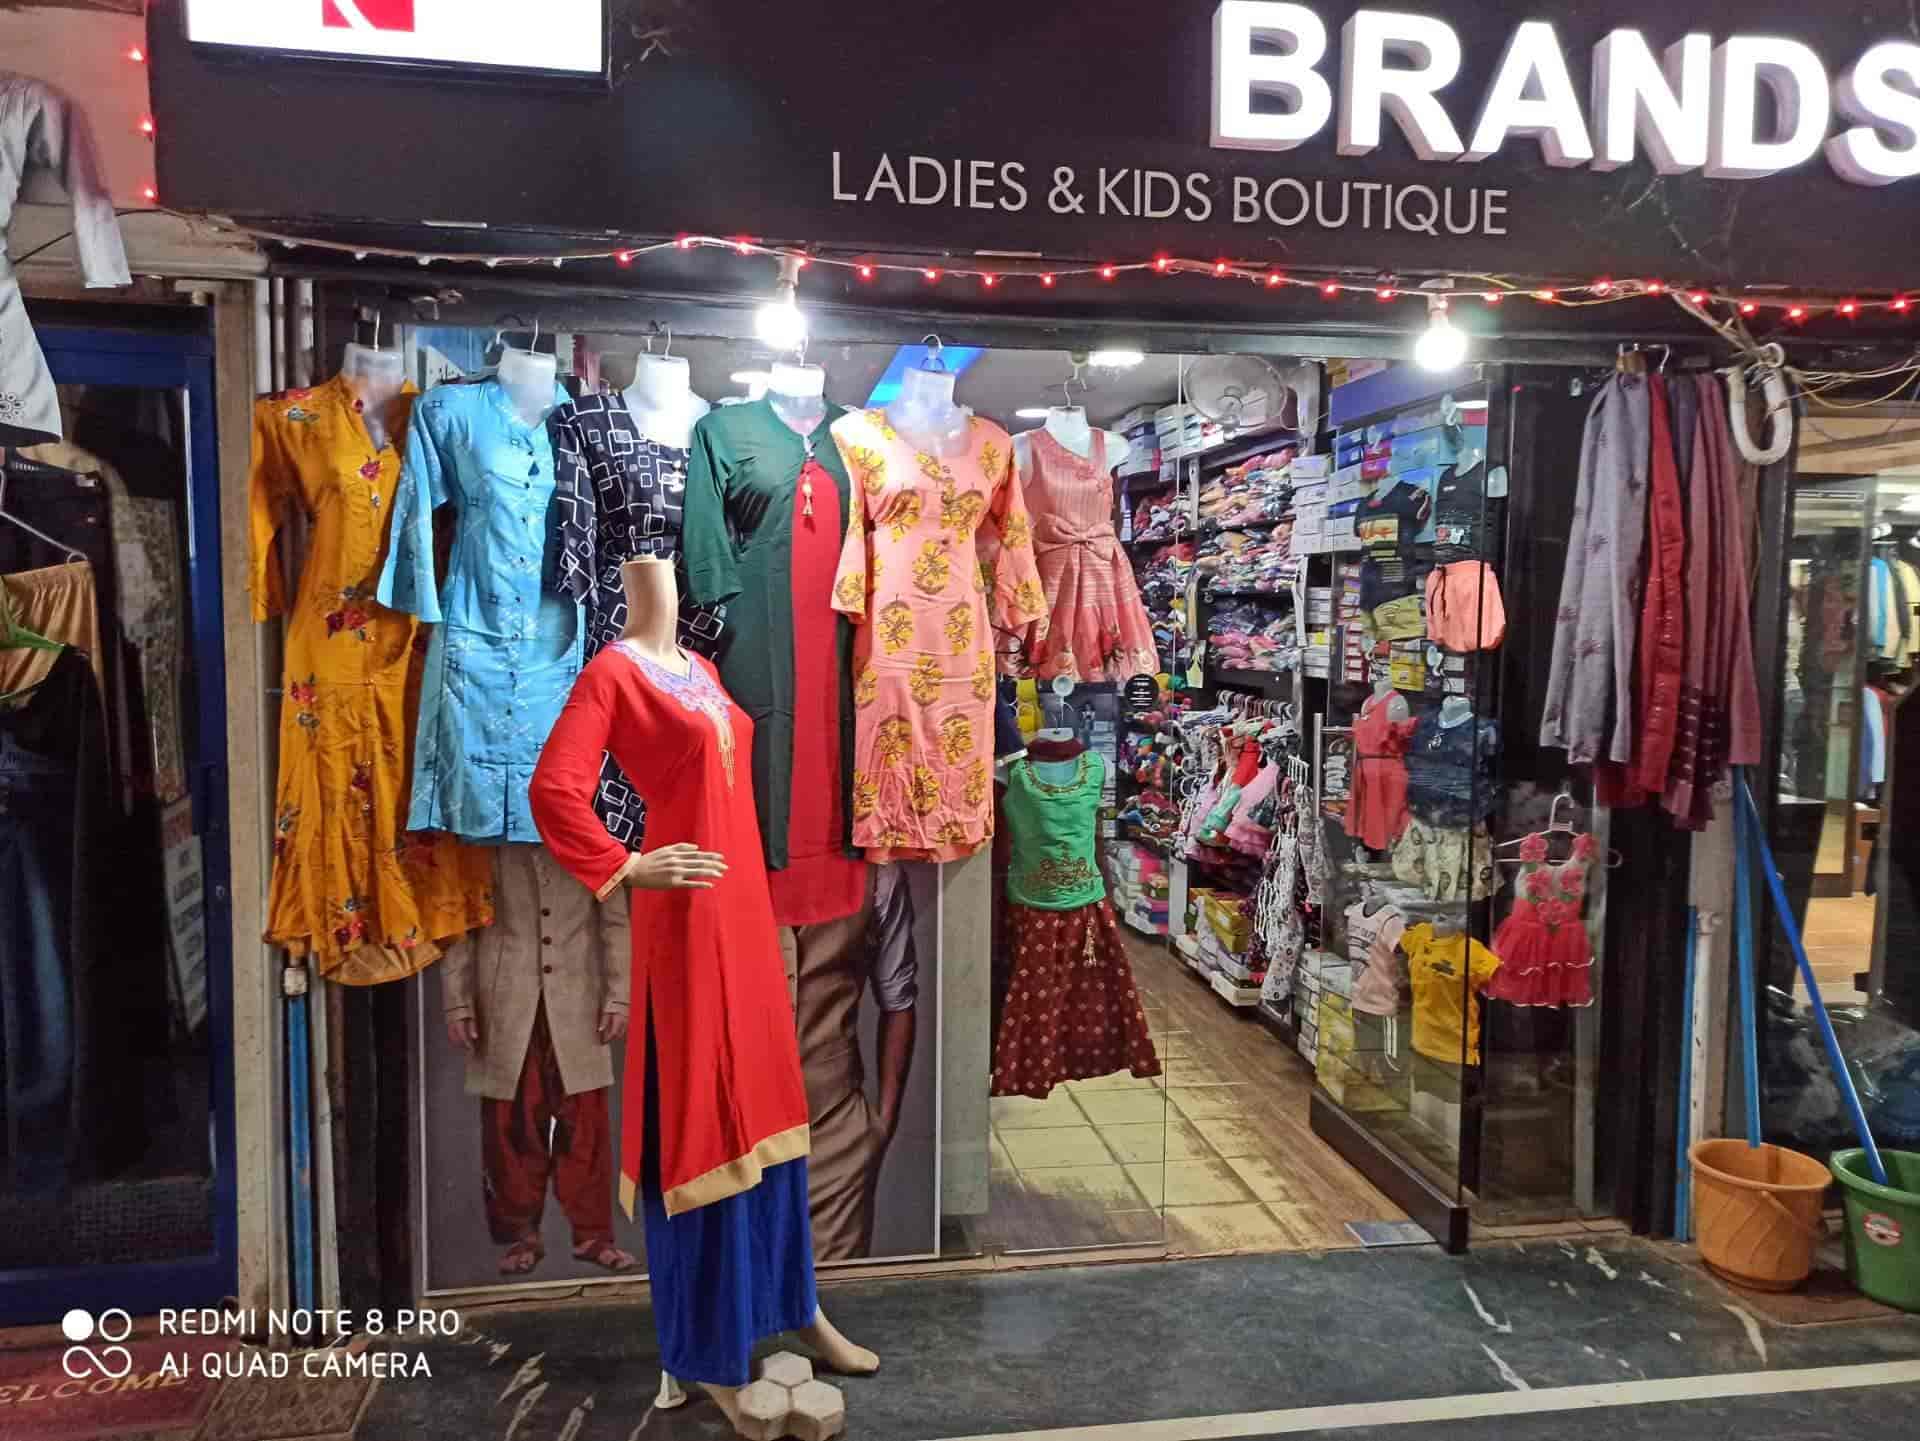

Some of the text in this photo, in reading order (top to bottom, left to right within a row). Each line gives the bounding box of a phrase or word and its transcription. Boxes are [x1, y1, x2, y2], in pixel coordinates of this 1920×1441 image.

[1211, 0, 1920, 187] BRANDS
[832, 151, 1508, 236] LADIES & KIDS BOUTIQUE
